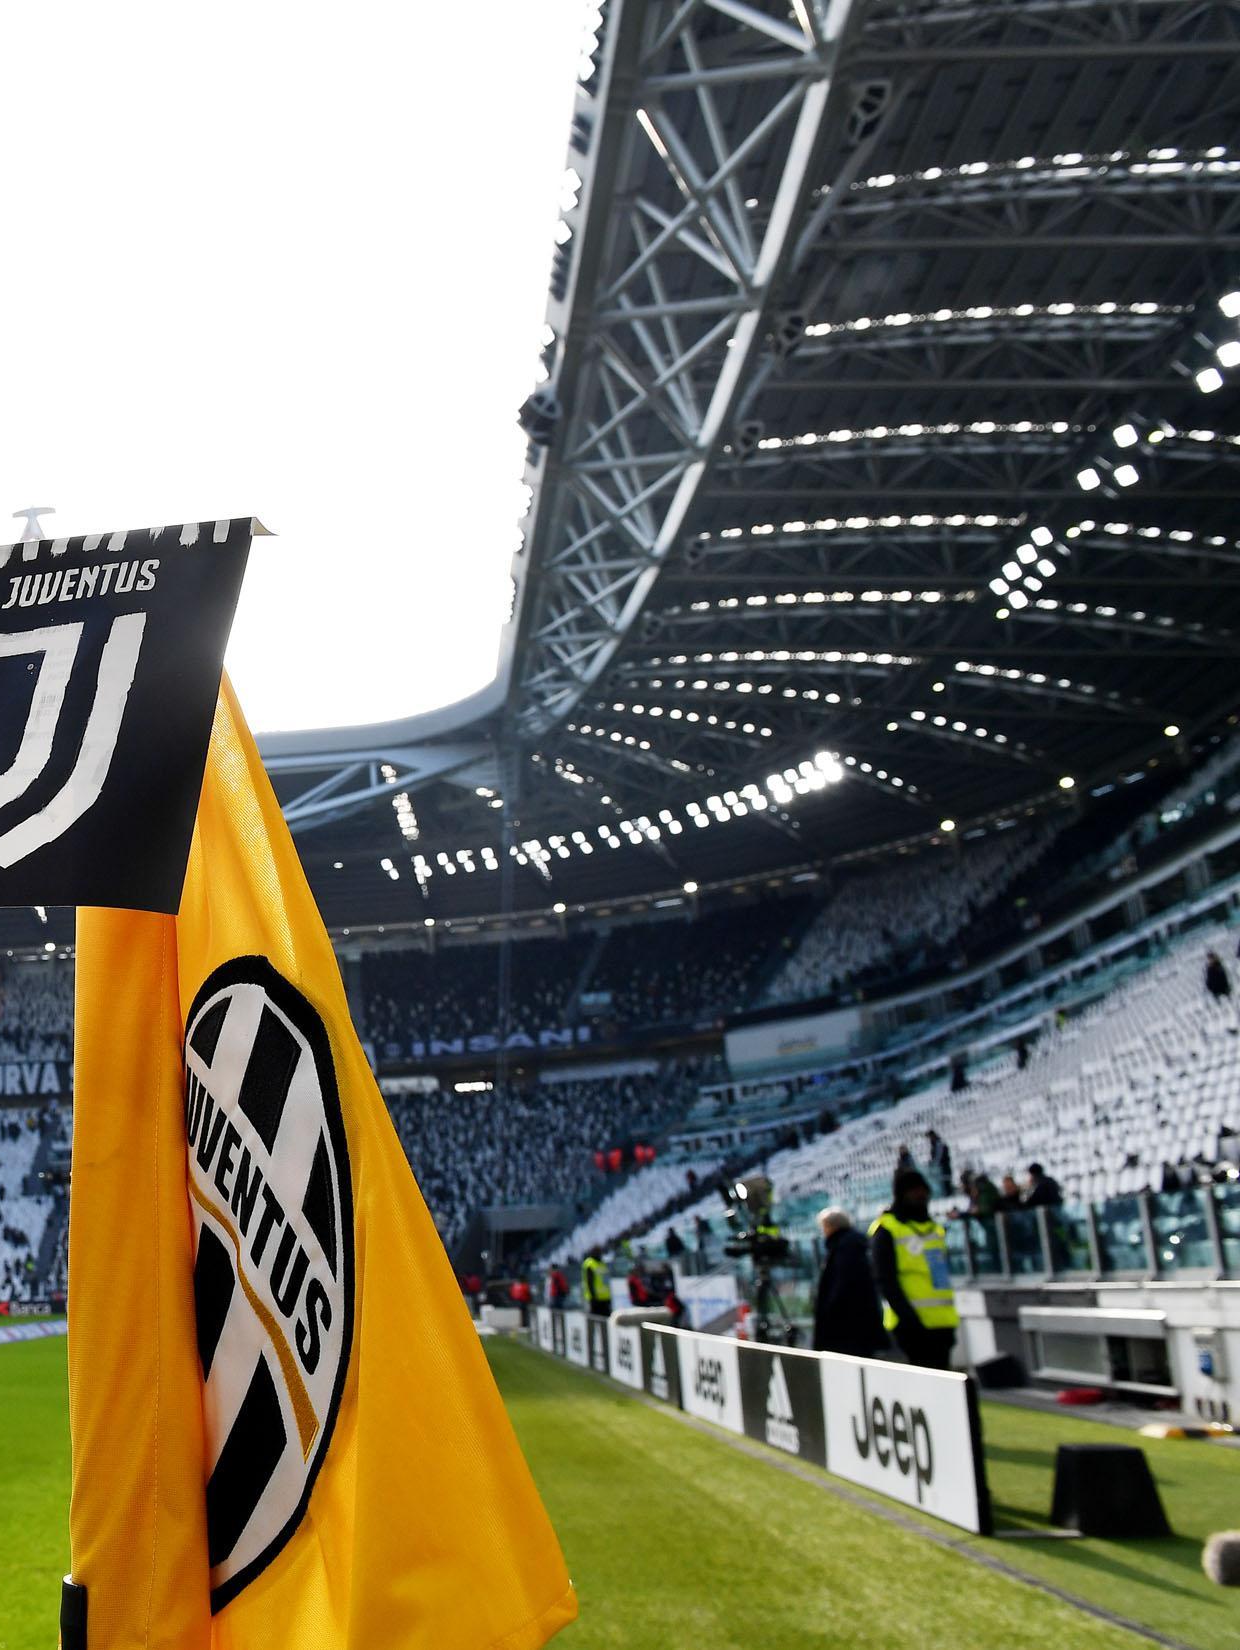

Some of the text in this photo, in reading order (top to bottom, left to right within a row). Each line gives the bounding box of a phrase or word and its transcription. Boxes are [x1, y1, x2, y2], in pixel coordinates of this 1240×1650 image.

[1, 559, 160, 609] JUVENTUS
[187, 1064, 332, 1375] UVENTUS
[851, 1367, 934, 1504] Jeep
